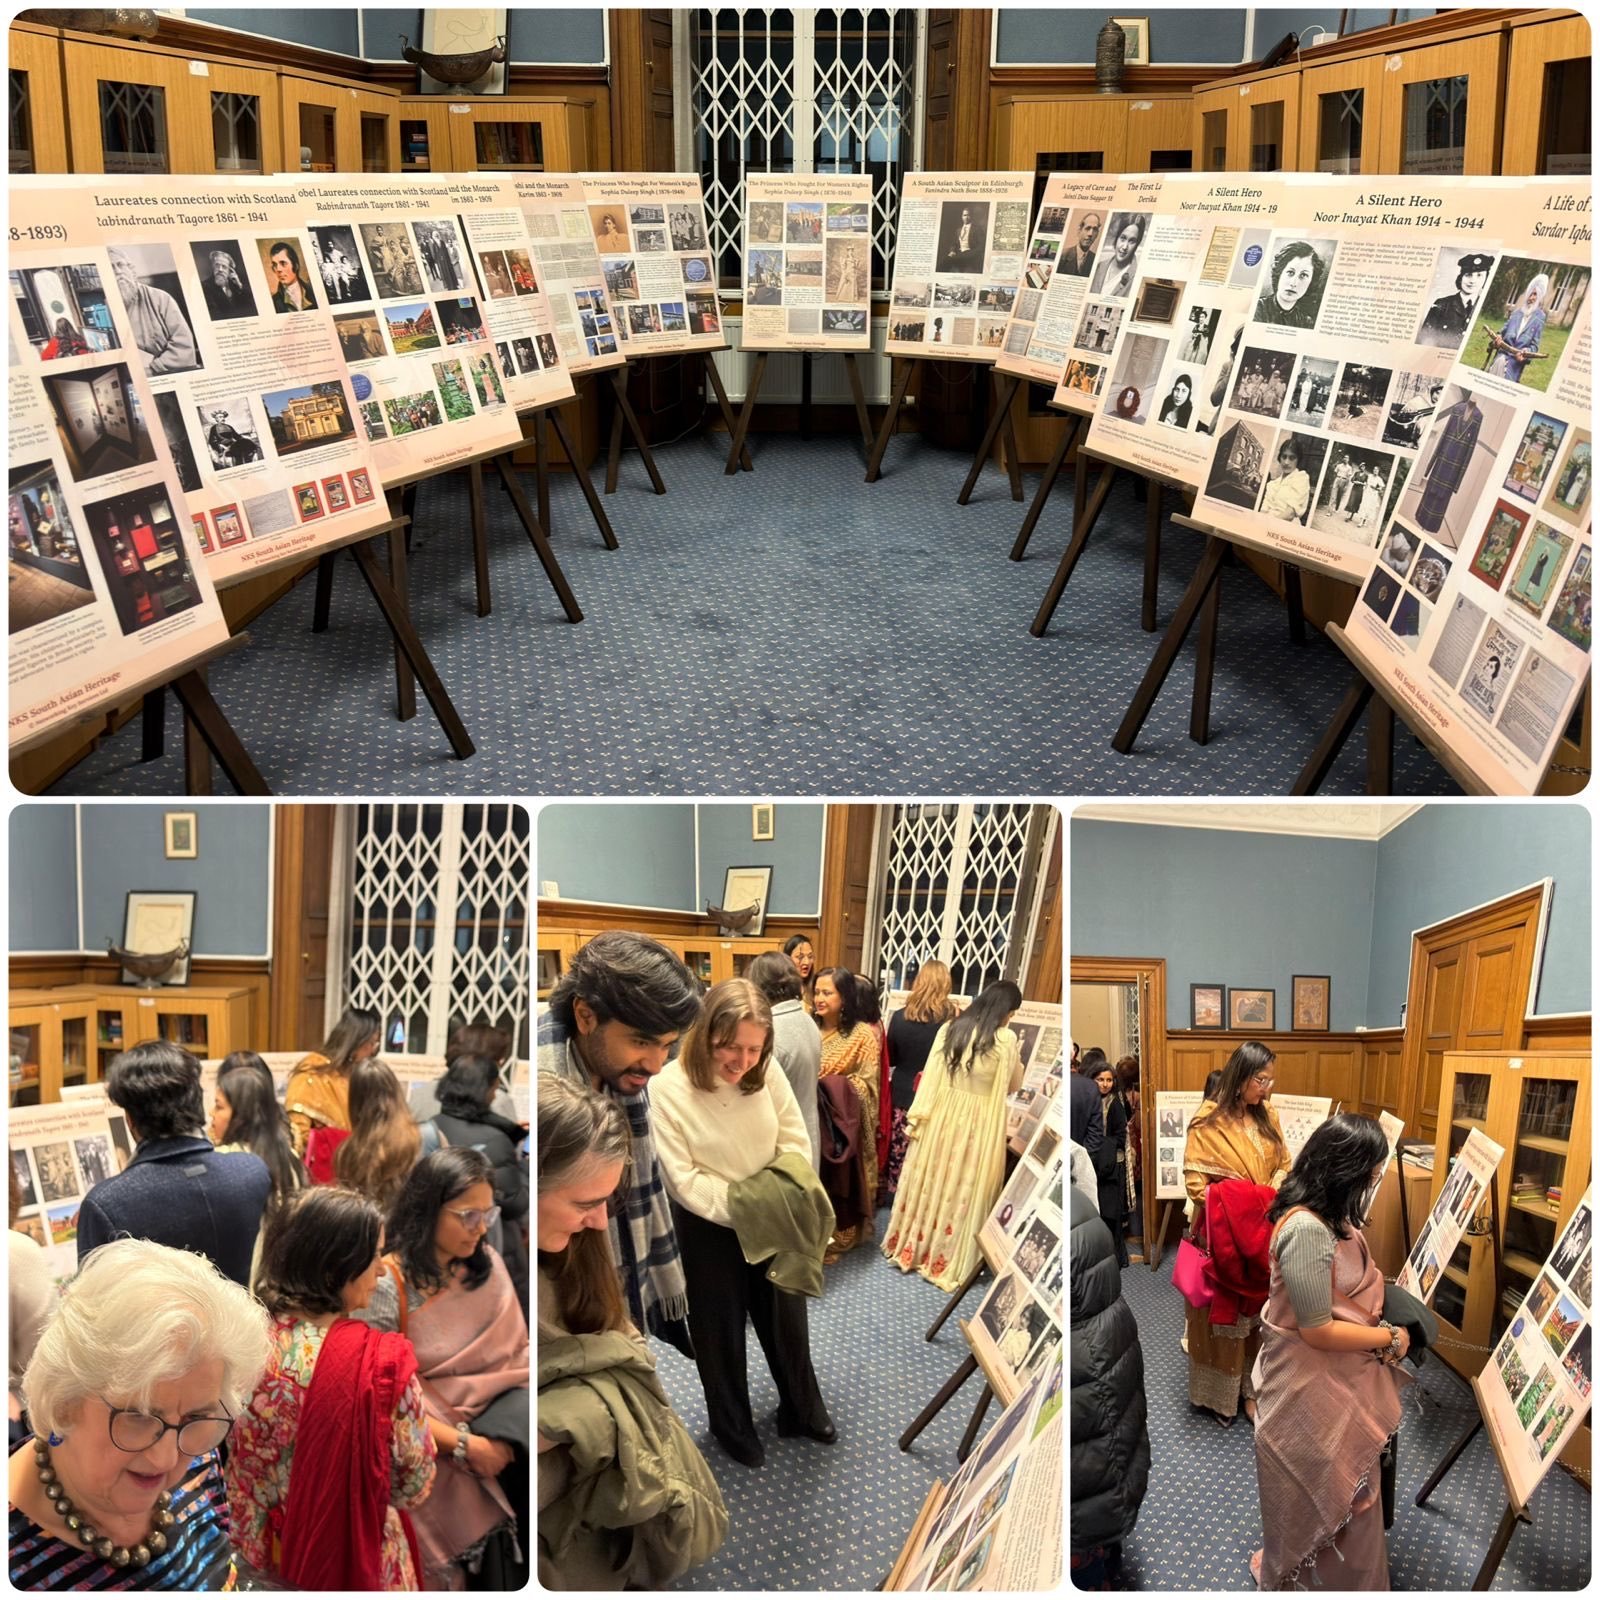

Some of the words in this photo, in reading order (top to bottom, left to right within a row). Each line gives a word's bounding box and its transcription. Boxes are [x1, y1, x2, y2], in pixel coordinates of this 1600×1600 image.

[297, 188, 316, 198] obel
[319, 188, 358, 197] Laureates
[360, 187, 402, 196] connection
[403, 187, 418, 195] with
[420, 187, 448, 196] Scotland
[473, 184, 500, 192] Monarch
[1105, 184, 1116, 192] and
[1128, 183, 1139, 191] The
[1140, 183, 1154, 191] First
[1208, 188, 1214, 197] A
[1215, 187, 1239, 197] Silent
[1241, 187, 1263, 198] Hero
[94, 195, 158, 206] Laureates
[161, 194, 225, 205] connection
[227, 193, 251, 204] with
[253, 193, 297, 204] Scotland
[316, 201, 369, 211] Rabindranath
[370, 201, 394, 211] Tagore
[1356, 194, 1365, 206] A
[1367, 194, 1405, 207] Silent
[1408, 195, 1442, 208] Hero
[1543, 195, 1553, 210] A
[1553, 195, 1575, 211] Life
[1576, 195, 1592, 212] of
[1180, 202, 1196, 210] Noor
[1197, 202, 1221, 213] Inayat
[1222, 202, 1242, 212] Khan
[1243, 203, 1260, 213] 1914
[177, 213, 214, 227] Tagore
[216, 213, 238, 223] 1861
[248, 212, 268, 222] 1941
[1314, 211, 1340, 222] Noor
[1341, 212, 1378, 226] Inayat
[1380, 213, 1412, 226] Khan
[1415, 215, 1441, 227] 1914
[1454, 217, 1485, 229] 1944
[1532, 221, 1568, 239] Sardar
[255, 547, 274, 557] South
[275, 542, 291, 551] Asian
[291, 533, 316, 548] Heritage
[1267, 531, 1280, 540] NKS
[1280, 533, 1297, 546] South
[1298, 541, 1314, 552] Asian
[1315, 547, 1342, 562] Heritage
[9, 712, 28, 728] NKS
[30, 700, 58, 718] South
[59, 689, 84, 705] Asian
[84, 671, 121, 694] Heritage
[1415, 689, 1430, 707] Asian
[1428, 702, 1450, 728] Heritage
